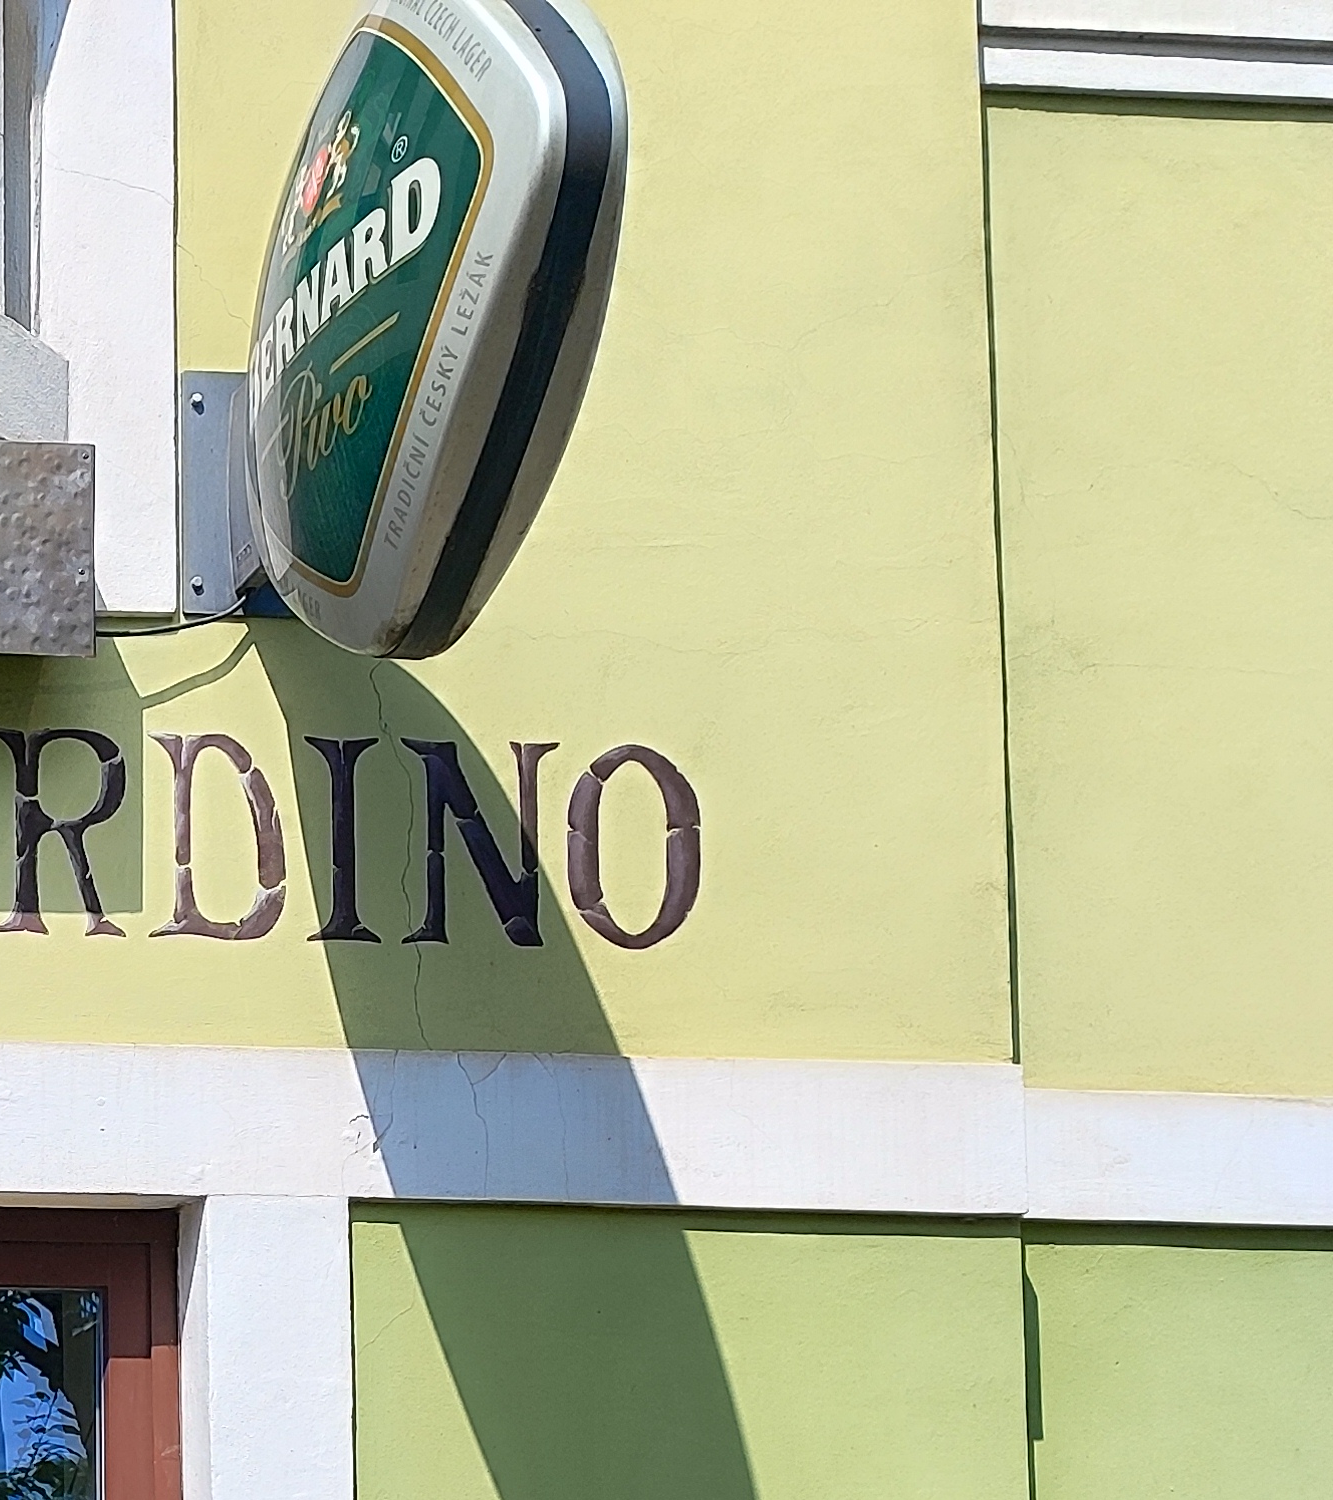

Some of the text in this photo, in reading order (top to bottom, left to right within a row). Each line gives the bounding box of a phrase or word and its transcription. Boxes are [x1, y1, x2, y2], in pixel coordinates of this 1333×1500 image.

[423, 0, 493, 83] CZECH LAGER
[261, 360, 373, 500] Pivo
[384, 251, 495, 551] TRADIČNÍ ČESKÝ LEŽÁK
